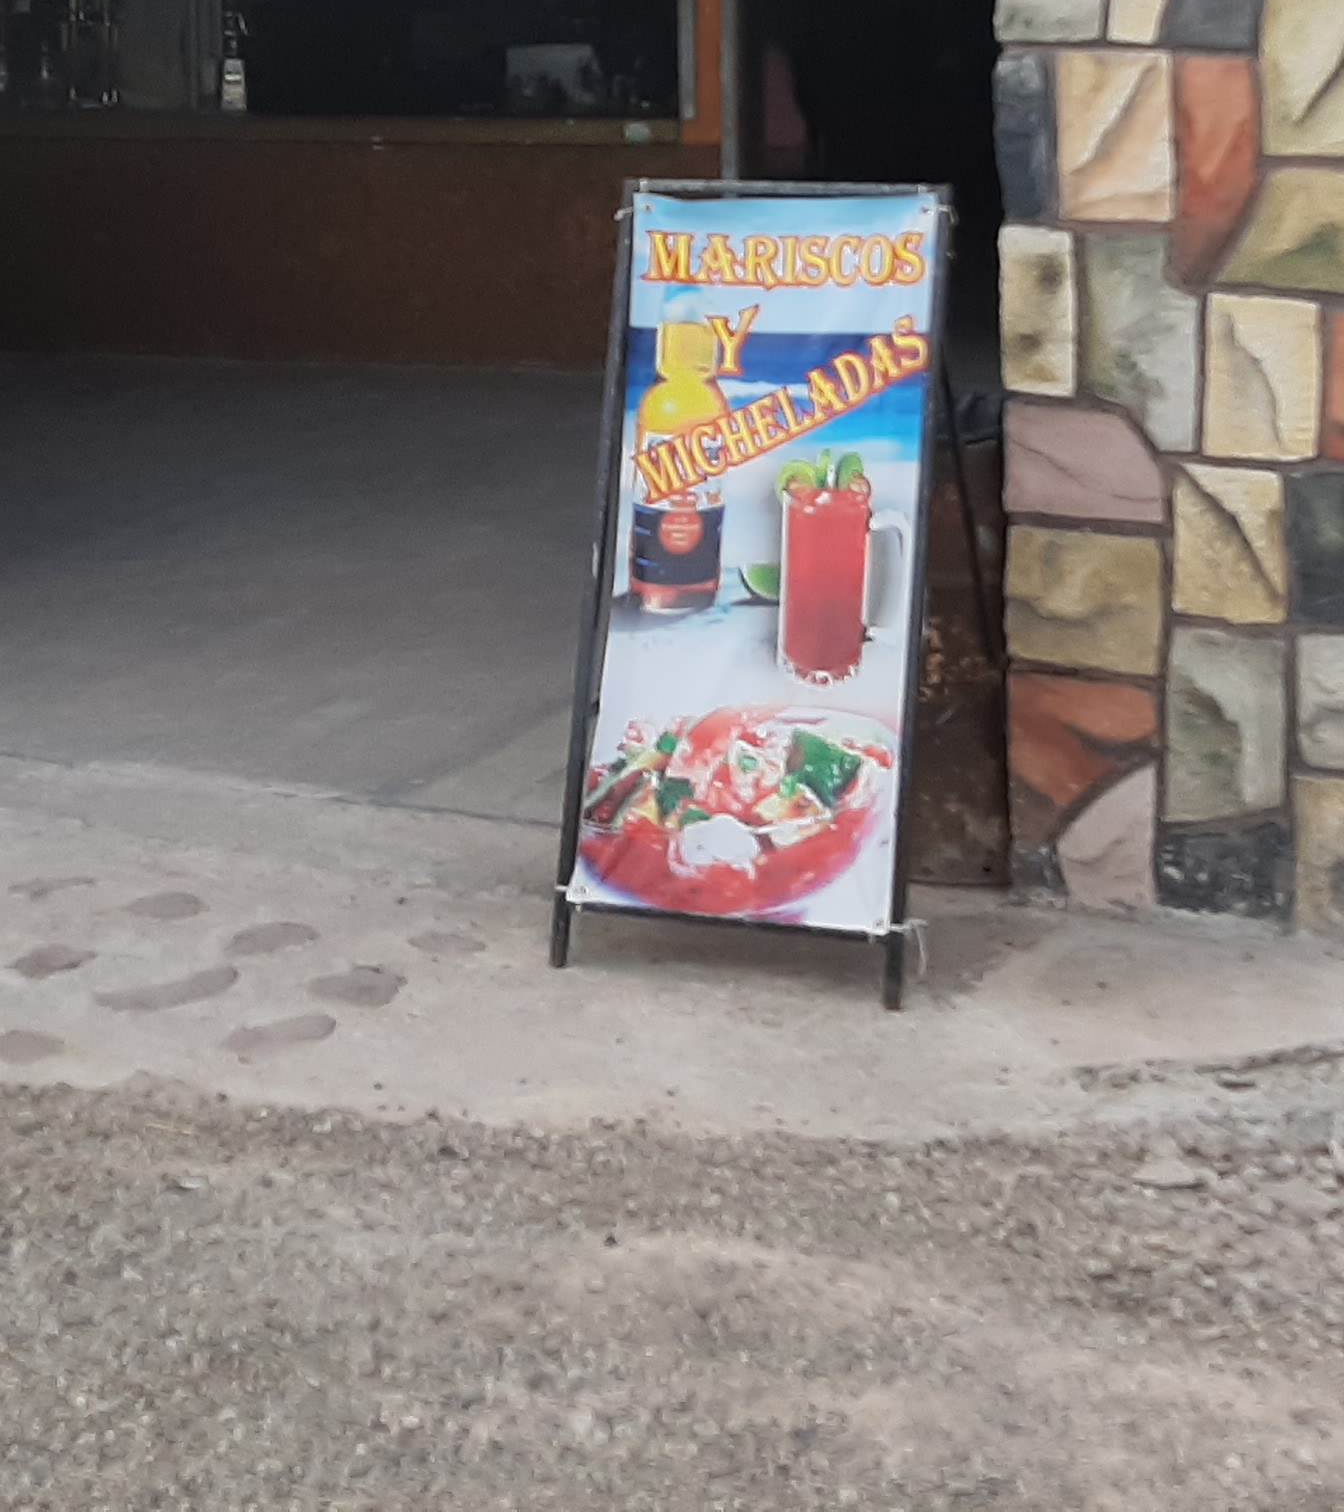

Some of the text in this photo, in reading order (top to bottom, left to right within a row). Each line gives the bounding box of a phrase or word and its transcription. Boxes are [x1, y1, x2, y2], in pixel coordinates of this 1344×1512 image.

[641, 230, 928, 289] MARISCOS
[705, 305, 760, 376] Y
[632, 314, 932, 504] MICHELADAS
